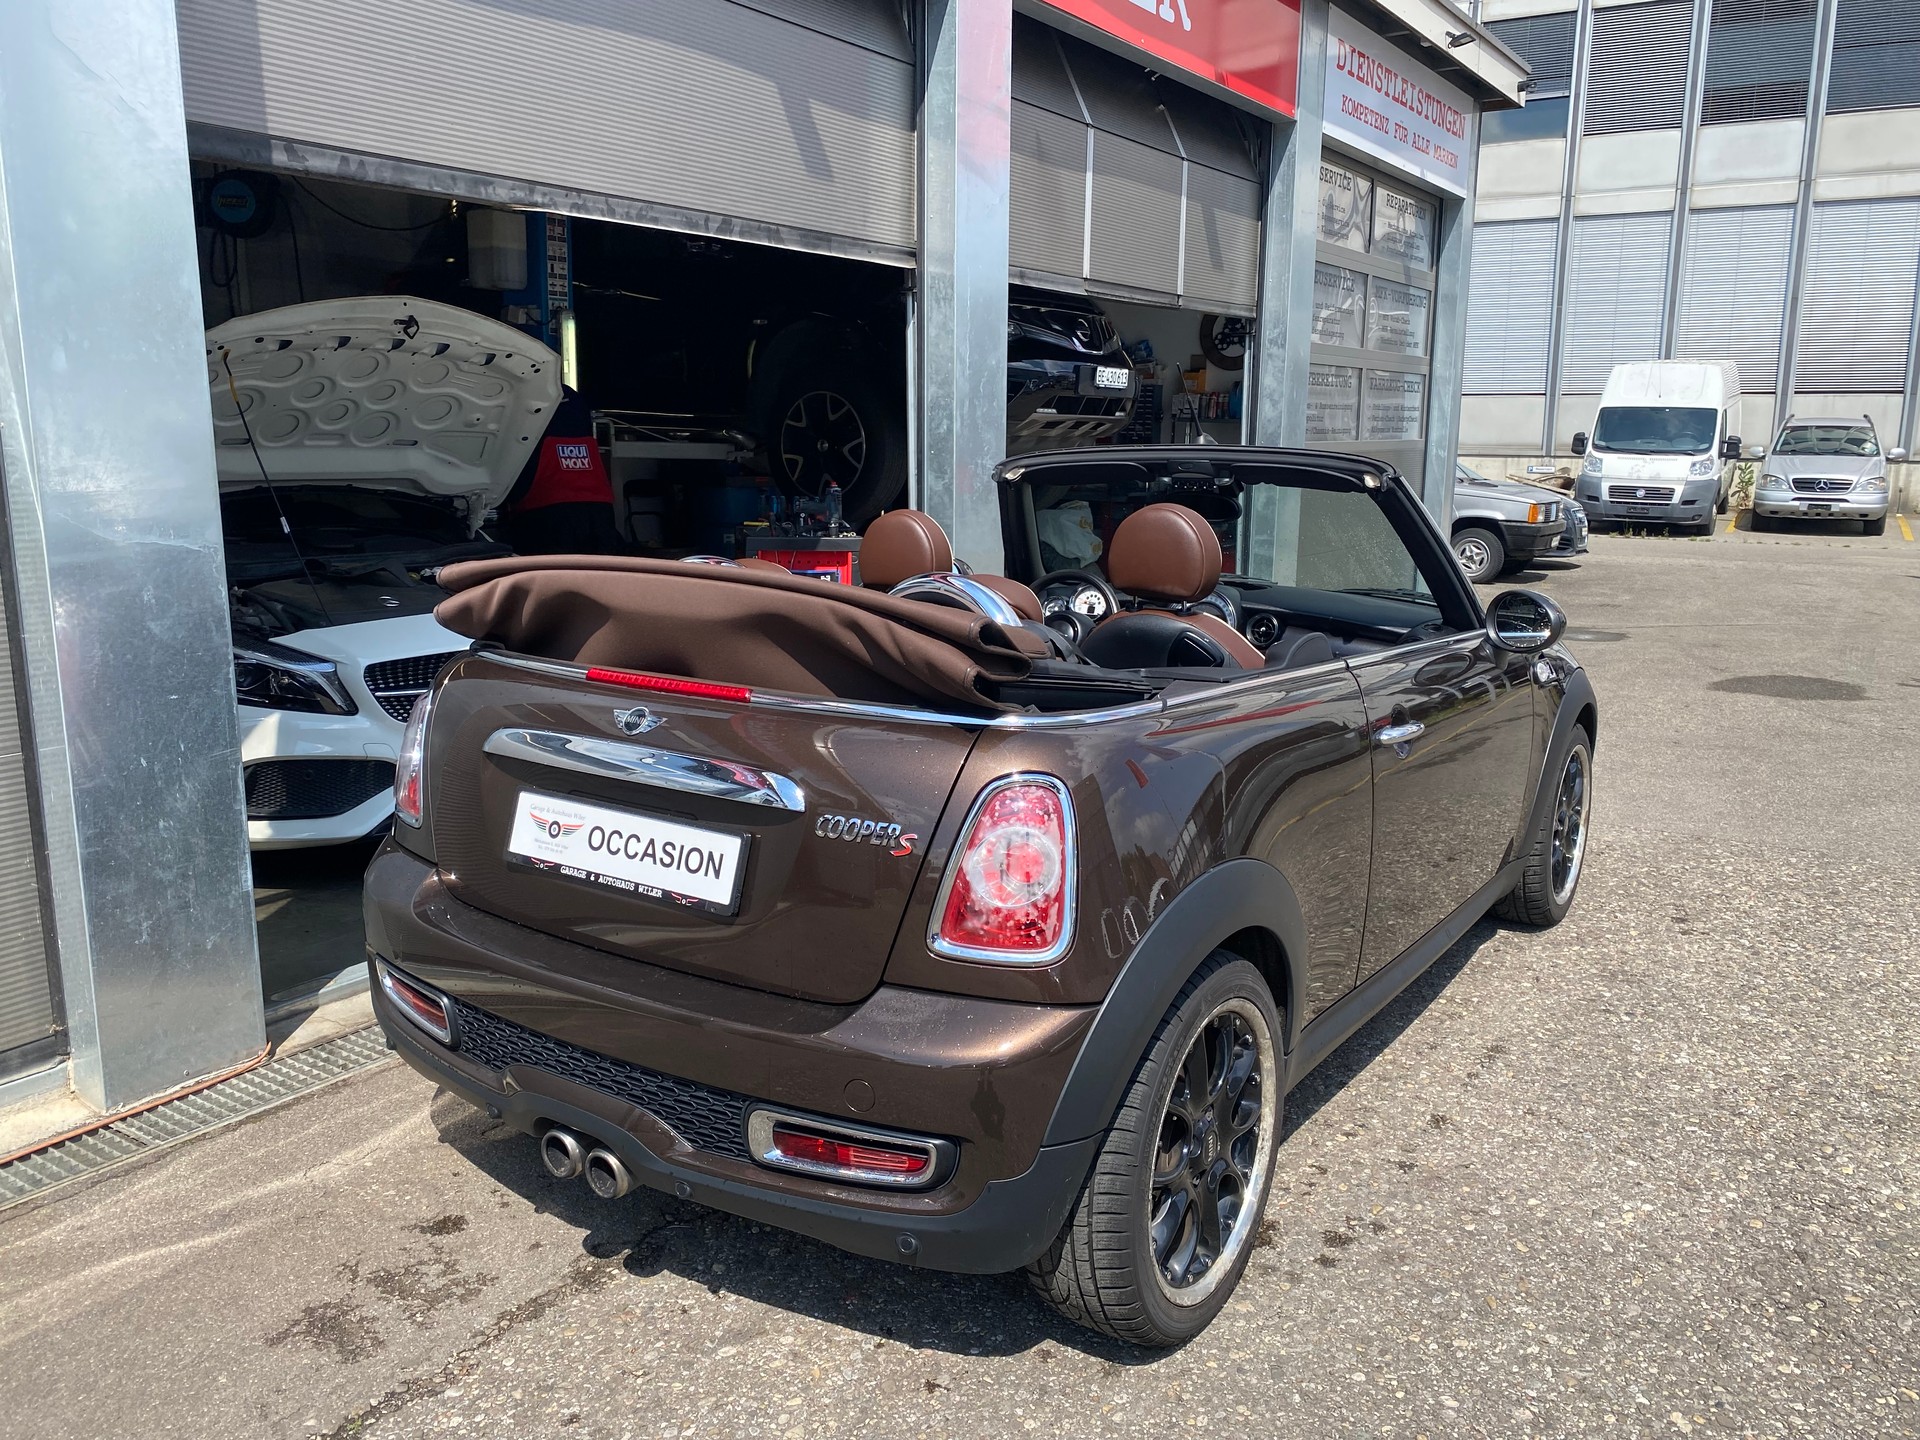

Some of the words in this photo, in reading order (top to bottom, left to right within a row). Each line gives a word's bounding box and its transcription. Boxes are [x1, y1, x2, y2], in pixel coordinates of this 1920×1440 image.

[1336, 38, 1466, 140] DIENSTLEISTUNGEN
[1341, 94, 1389, 135] KOMPETENZ
[1393, 120, 1409, 144] FÜR
[1411, 132, 1431, 155] ALLE
[1433, 143, 1459, 169] MARKEN
[1319, 165, 1352, 192] SERVICE
[559, 446, 587, 458] LIQUI
[561, 458, 589, 469] MOLY
[626, 715, 645, 725] MINI
[815, 814, 901, 848] COOPER
[889, 833, 918, 857] S
[587, 825, 724, 880] OCCASION
[560, 865, 587, 879] GARAGE
[590, 873, 595, 881] &
[598, 875, 635, 891] AUTOHAUS
[638, 885, 663, 898] WILER
